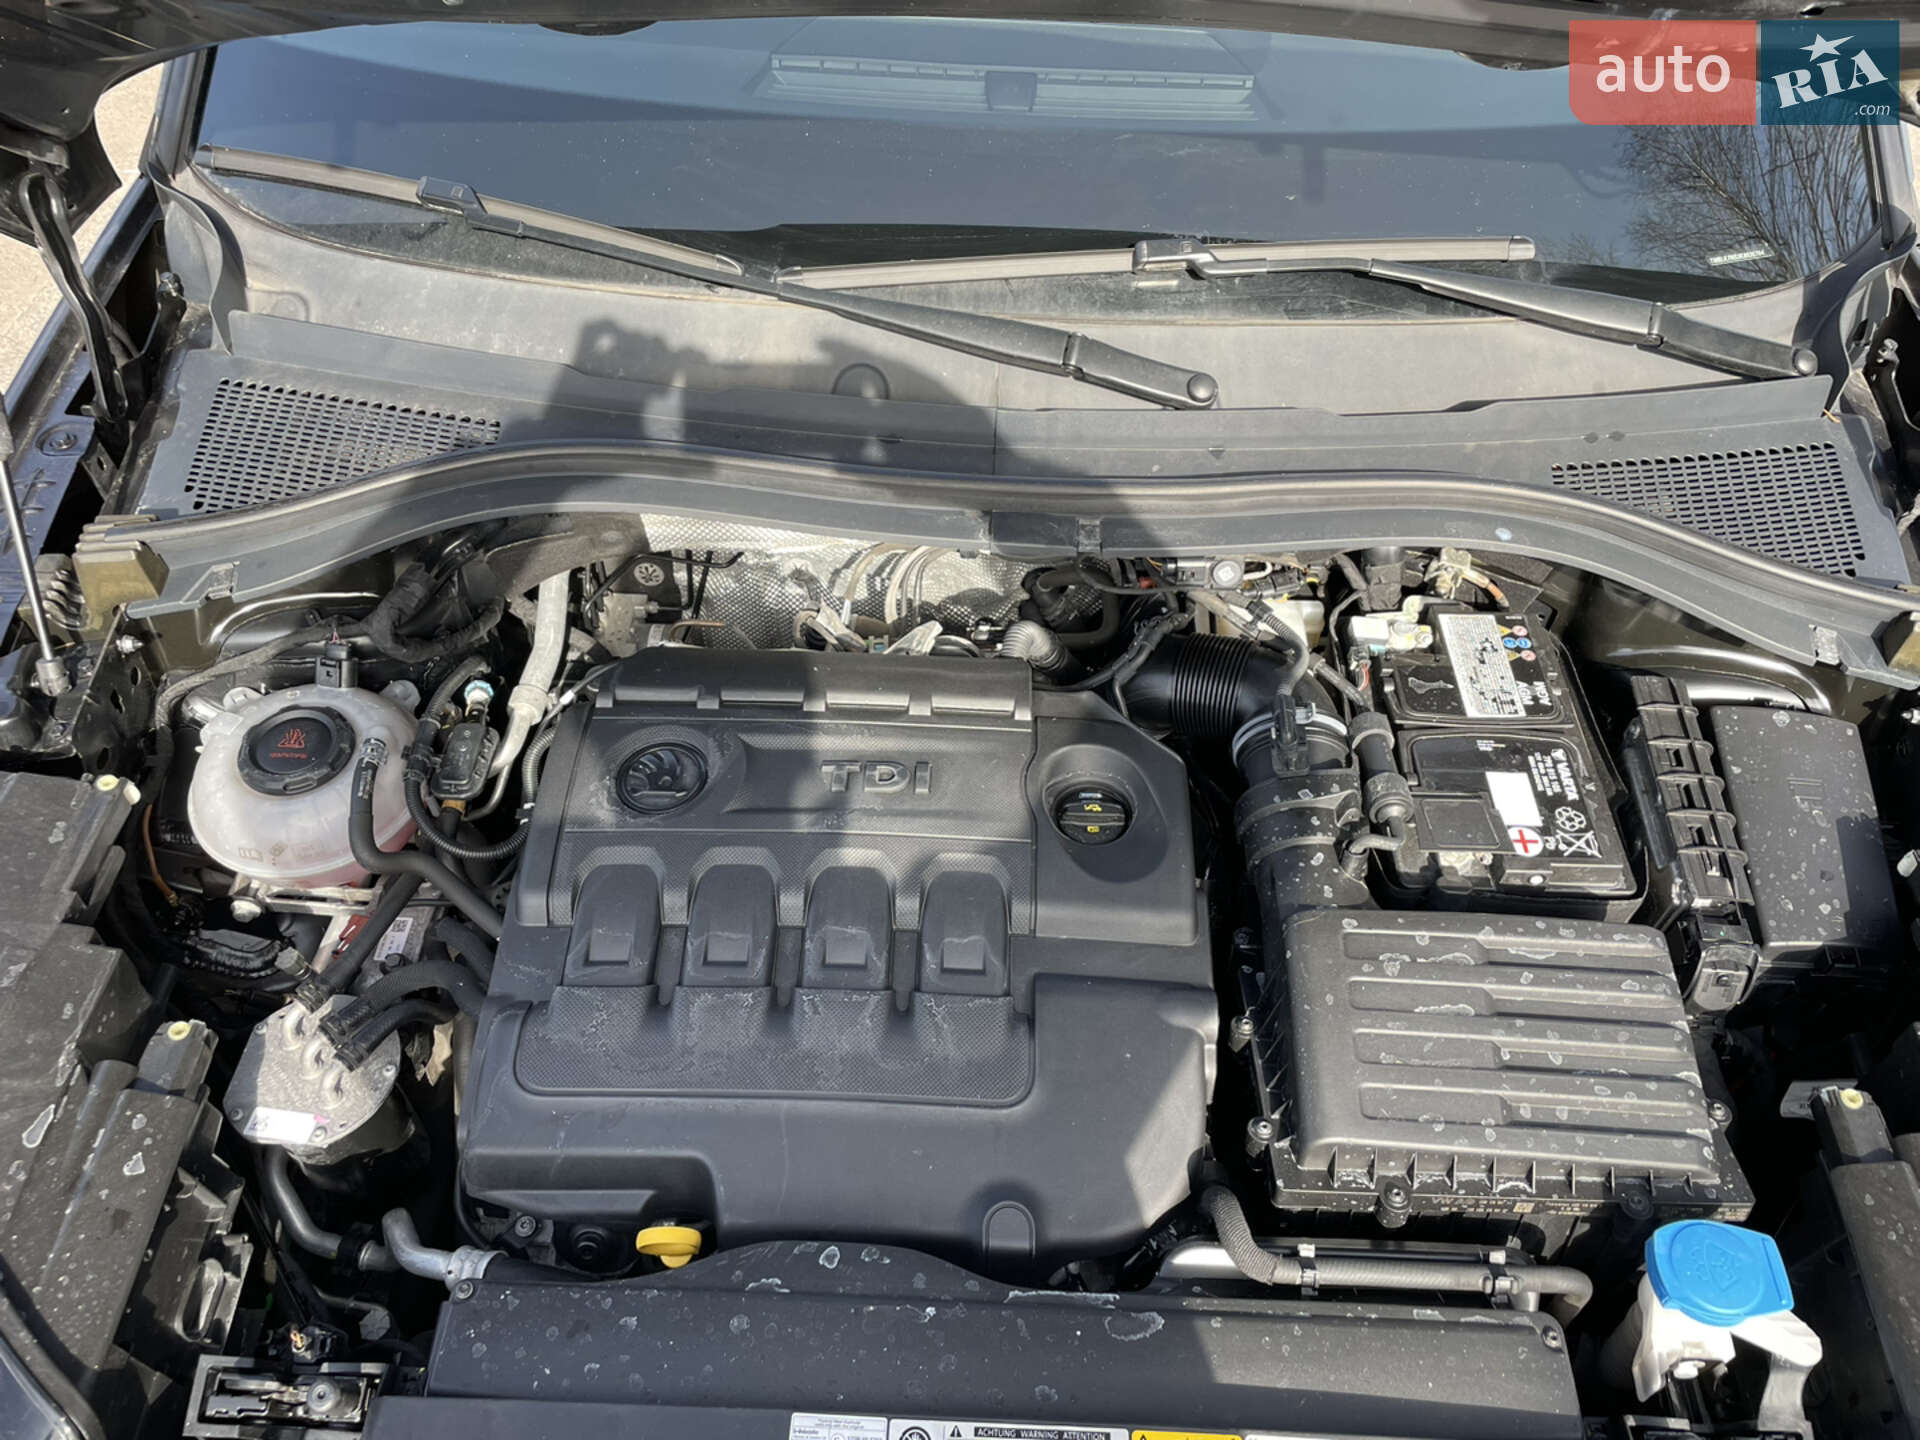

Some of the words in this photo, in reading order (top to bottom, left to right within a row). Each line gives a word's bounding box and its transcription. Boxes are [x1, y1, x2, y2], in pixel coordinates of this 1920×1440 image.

[821, 760, 932, 794] TDI
[1557, 762, 1579, 800] VARTA
[977, 1427, 1017, 1438] ACHTUNG
[1020, 1429, 1059, 1439] WARNING
[1062, 1431, 1106, 1440] ATTENTION
